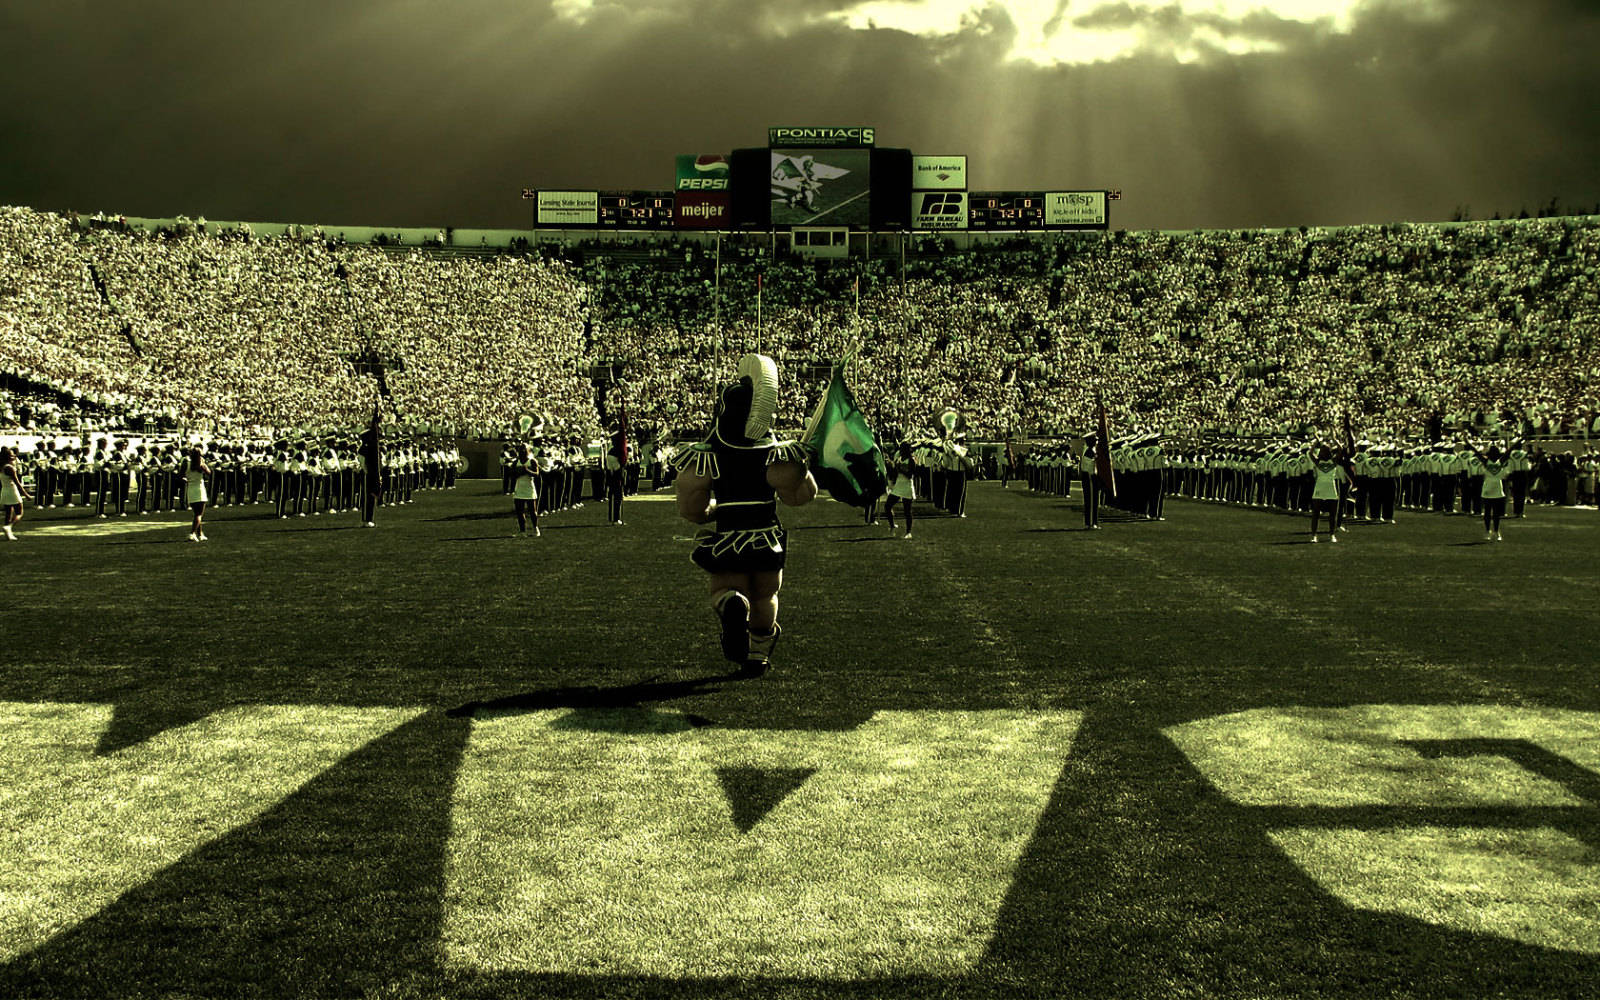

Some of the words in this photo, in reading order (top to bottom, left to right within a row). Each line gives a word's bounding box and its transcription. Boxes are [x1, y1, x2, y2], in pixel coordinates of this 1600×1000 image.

[777, 129, 859, 137] PONTIAC
[679, 178, 728, 189] PEPSI
[682, 202, 724, 219] meijer
